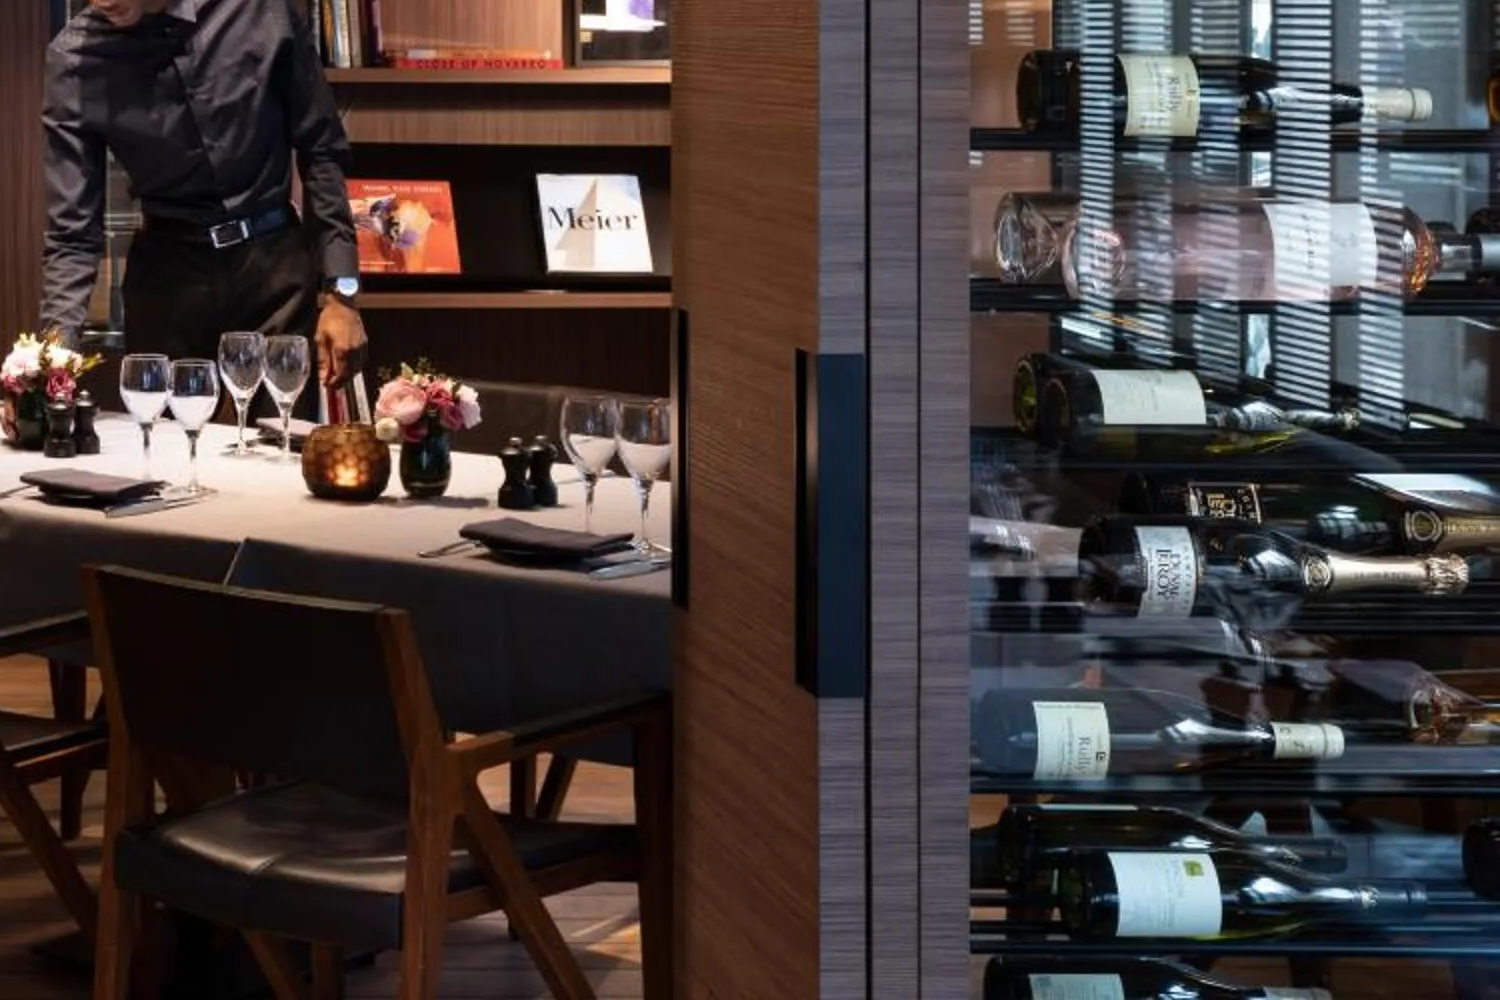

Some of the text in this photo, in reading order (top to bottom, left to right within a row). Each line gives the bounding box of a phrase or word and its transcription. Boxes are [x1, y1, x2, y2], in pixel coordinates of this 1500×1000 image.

[547, 207, 638, 230] Meier
[1155, 548, 1174, 601] LEROY
[1170, 553, 1182, 597] DUVAL
